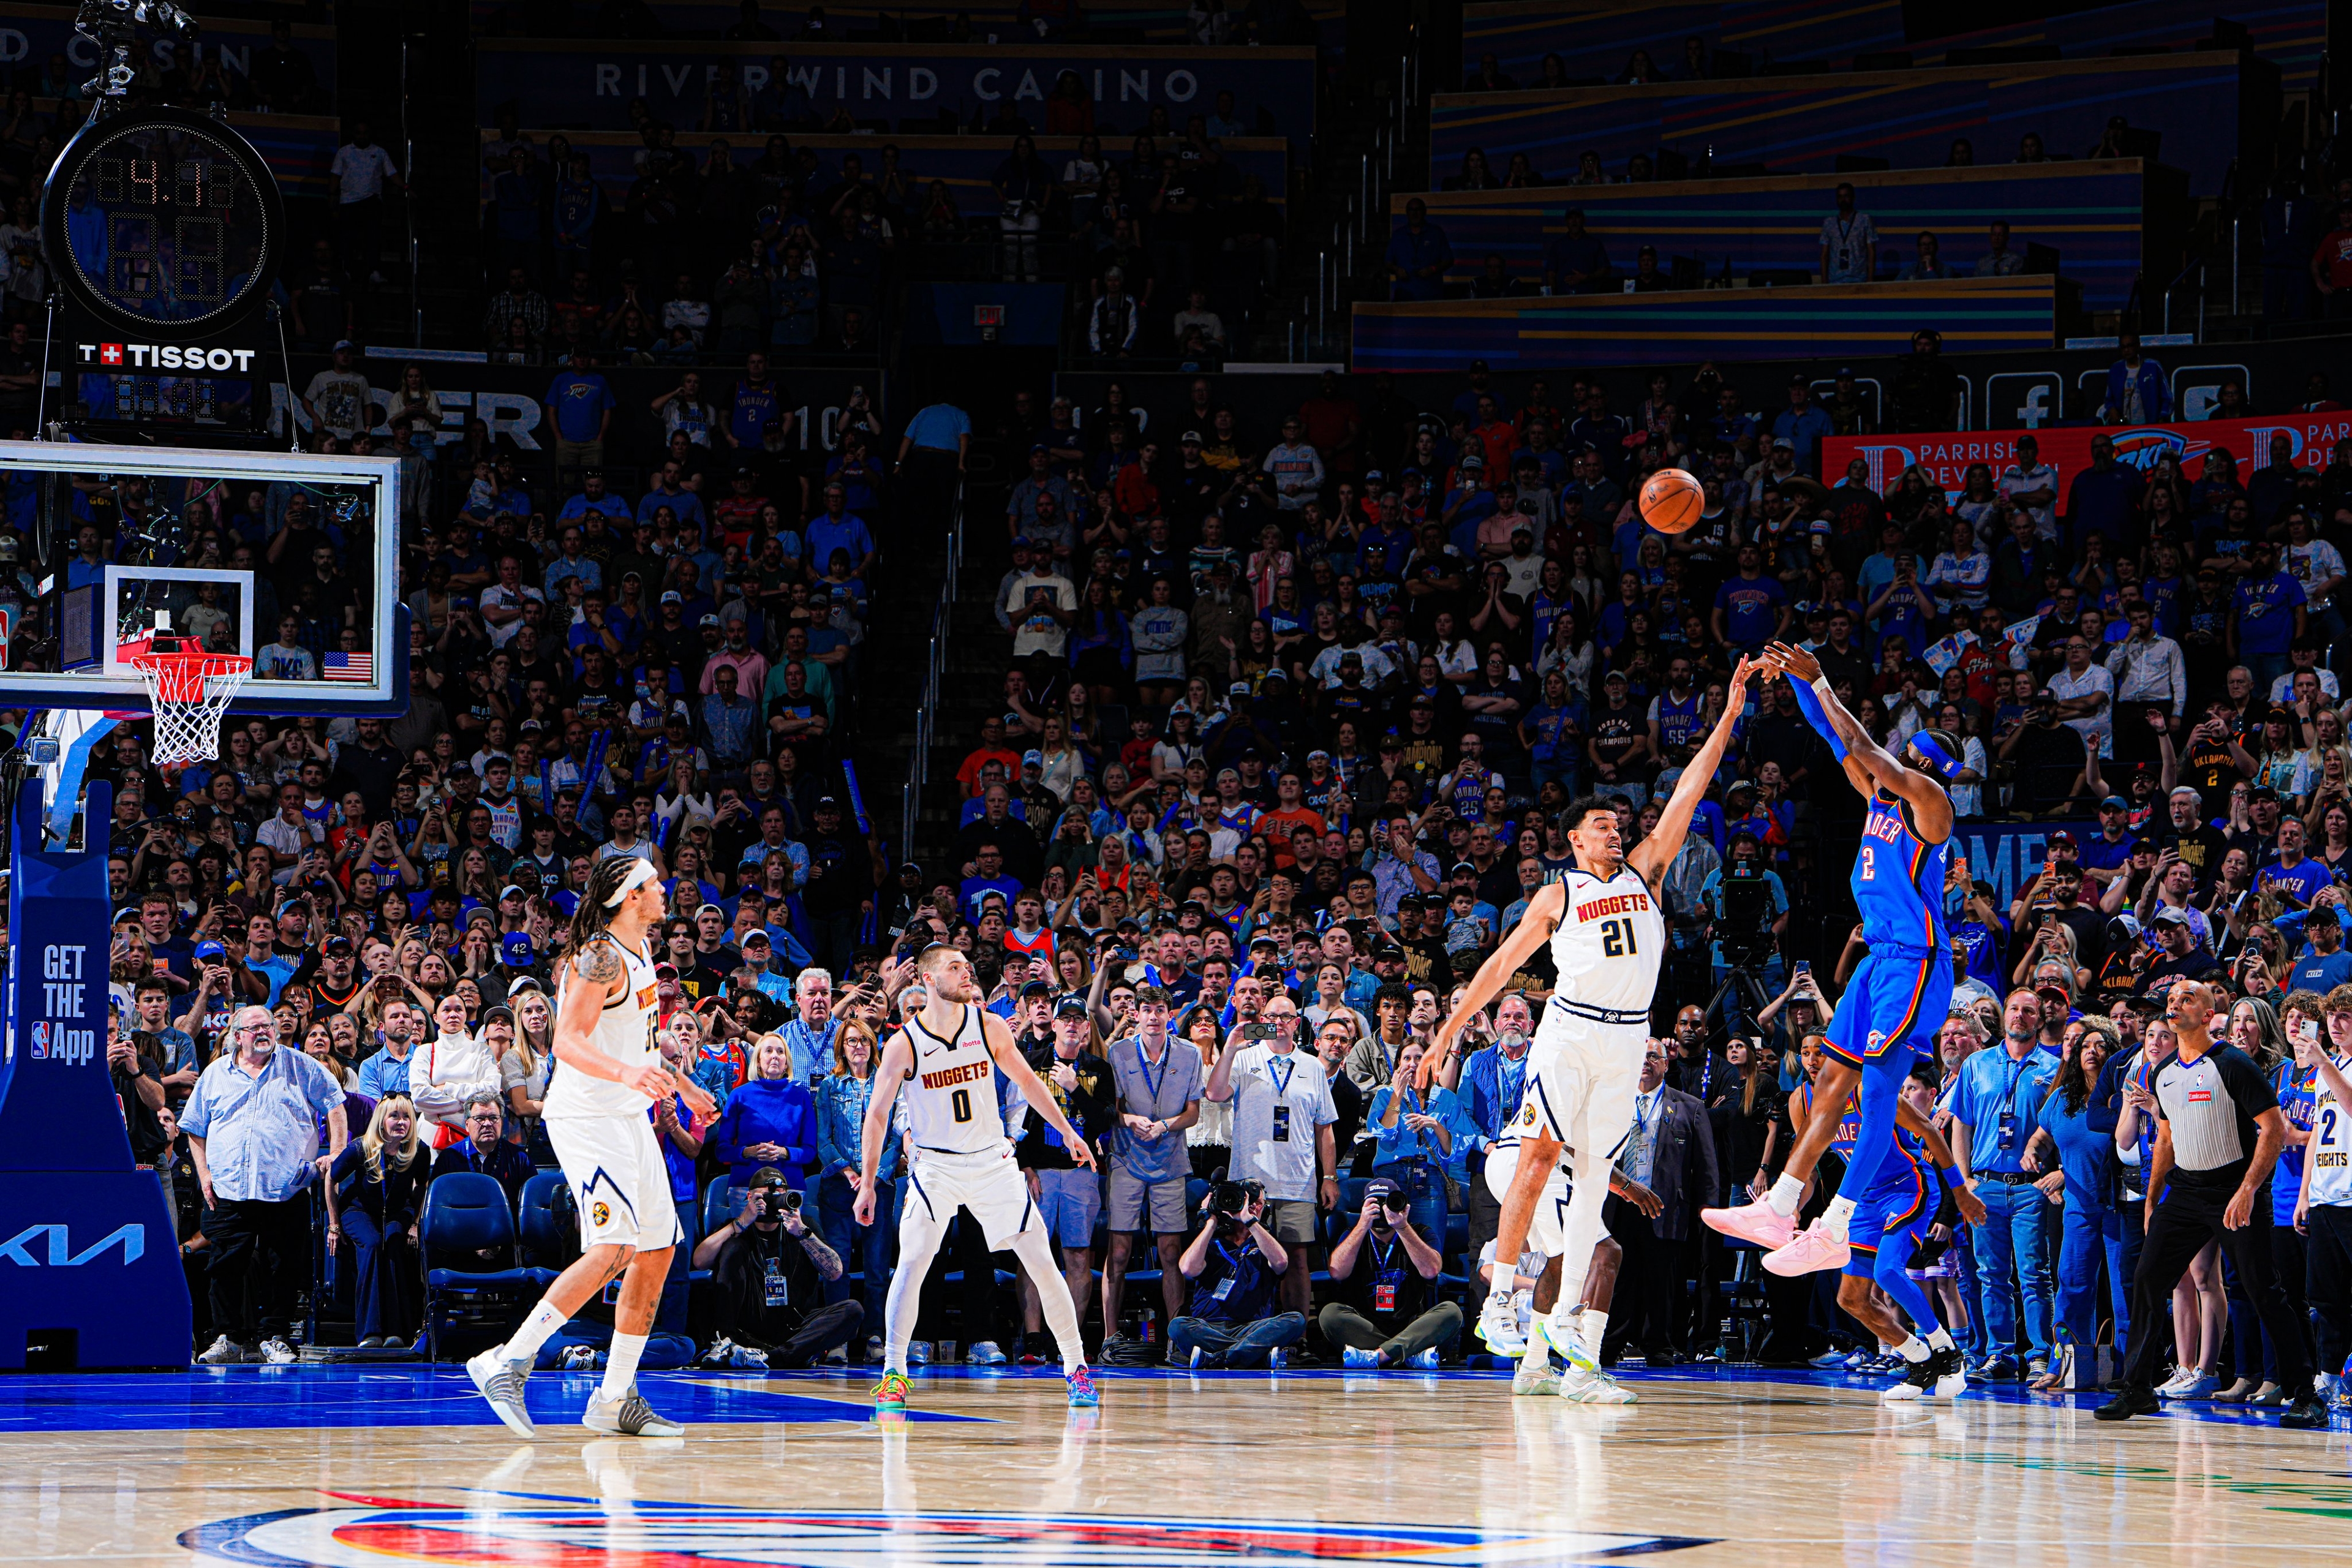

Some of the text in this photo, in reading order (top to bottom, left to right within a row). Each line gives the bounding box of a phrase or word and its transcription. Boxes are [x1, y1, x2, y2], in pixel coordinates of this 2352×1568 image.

[67, 35, 251, 79] CSIN
[973, 66, 1199, 103] CAINO
[568, 206, 576, 221] 2
[979, 309, 1001, 325] EXIT
[78, 344, 255, 372] T TISSOT
[738, 397, 769, 409] THUNDER
[747, 409, 756, 423] 2
[2308, 425, 2352, 443] PAR
[1920, 442, 2019, 462] PARRISH
[1924, 462, 2059, 484] DEVU
[1713, 525, 1724, 537] 15
[1768, 552, 1776, 566] 2
[1728, 590, 1768, 604] THUNDER
[1896, 607, 1905, 621] 2
[2154, 600, 2162, 612] 2
[1474, 715, 1507, 725] BASKETBALL
[1598, 719, 1631, 733] 2025 NBA
[1597, 737, 1632, 747] CHAMPIONS
[1668, 729, 1686, 745] 55
[2195, 753, 2236, 767] OKLAHOMA
[2207, 769, 2218, 786] 2
[1461, 802, 1479, 815] 25
[494, 814, 519, 826] AHOMA
[1863, 810, 1903, 844] NDER
[1861, 845, 1875, 881] 2
[540, 875, 559, 884] KC
[542, 885, 548, 897] 7
[1577, 894, 1649, 922] NUGGETS
[1602, 918, 1638, 957] 21
[511, 943, 526, 954] 42
[44, 944, 86, 979] GET
[43, 983, 86, 1017] THE
[646, 1014, 660, 1053] 32
[51, 1022, 94, 1066] App
[921, 1060, 988, 1090] NUGGETS
[952, 1090, 972, 1123] 0
[2322, 1110, 2336, 1145] 2
[816, 1254, 825, 1262] THE
[824, 1263, 834, 1273] TIME
